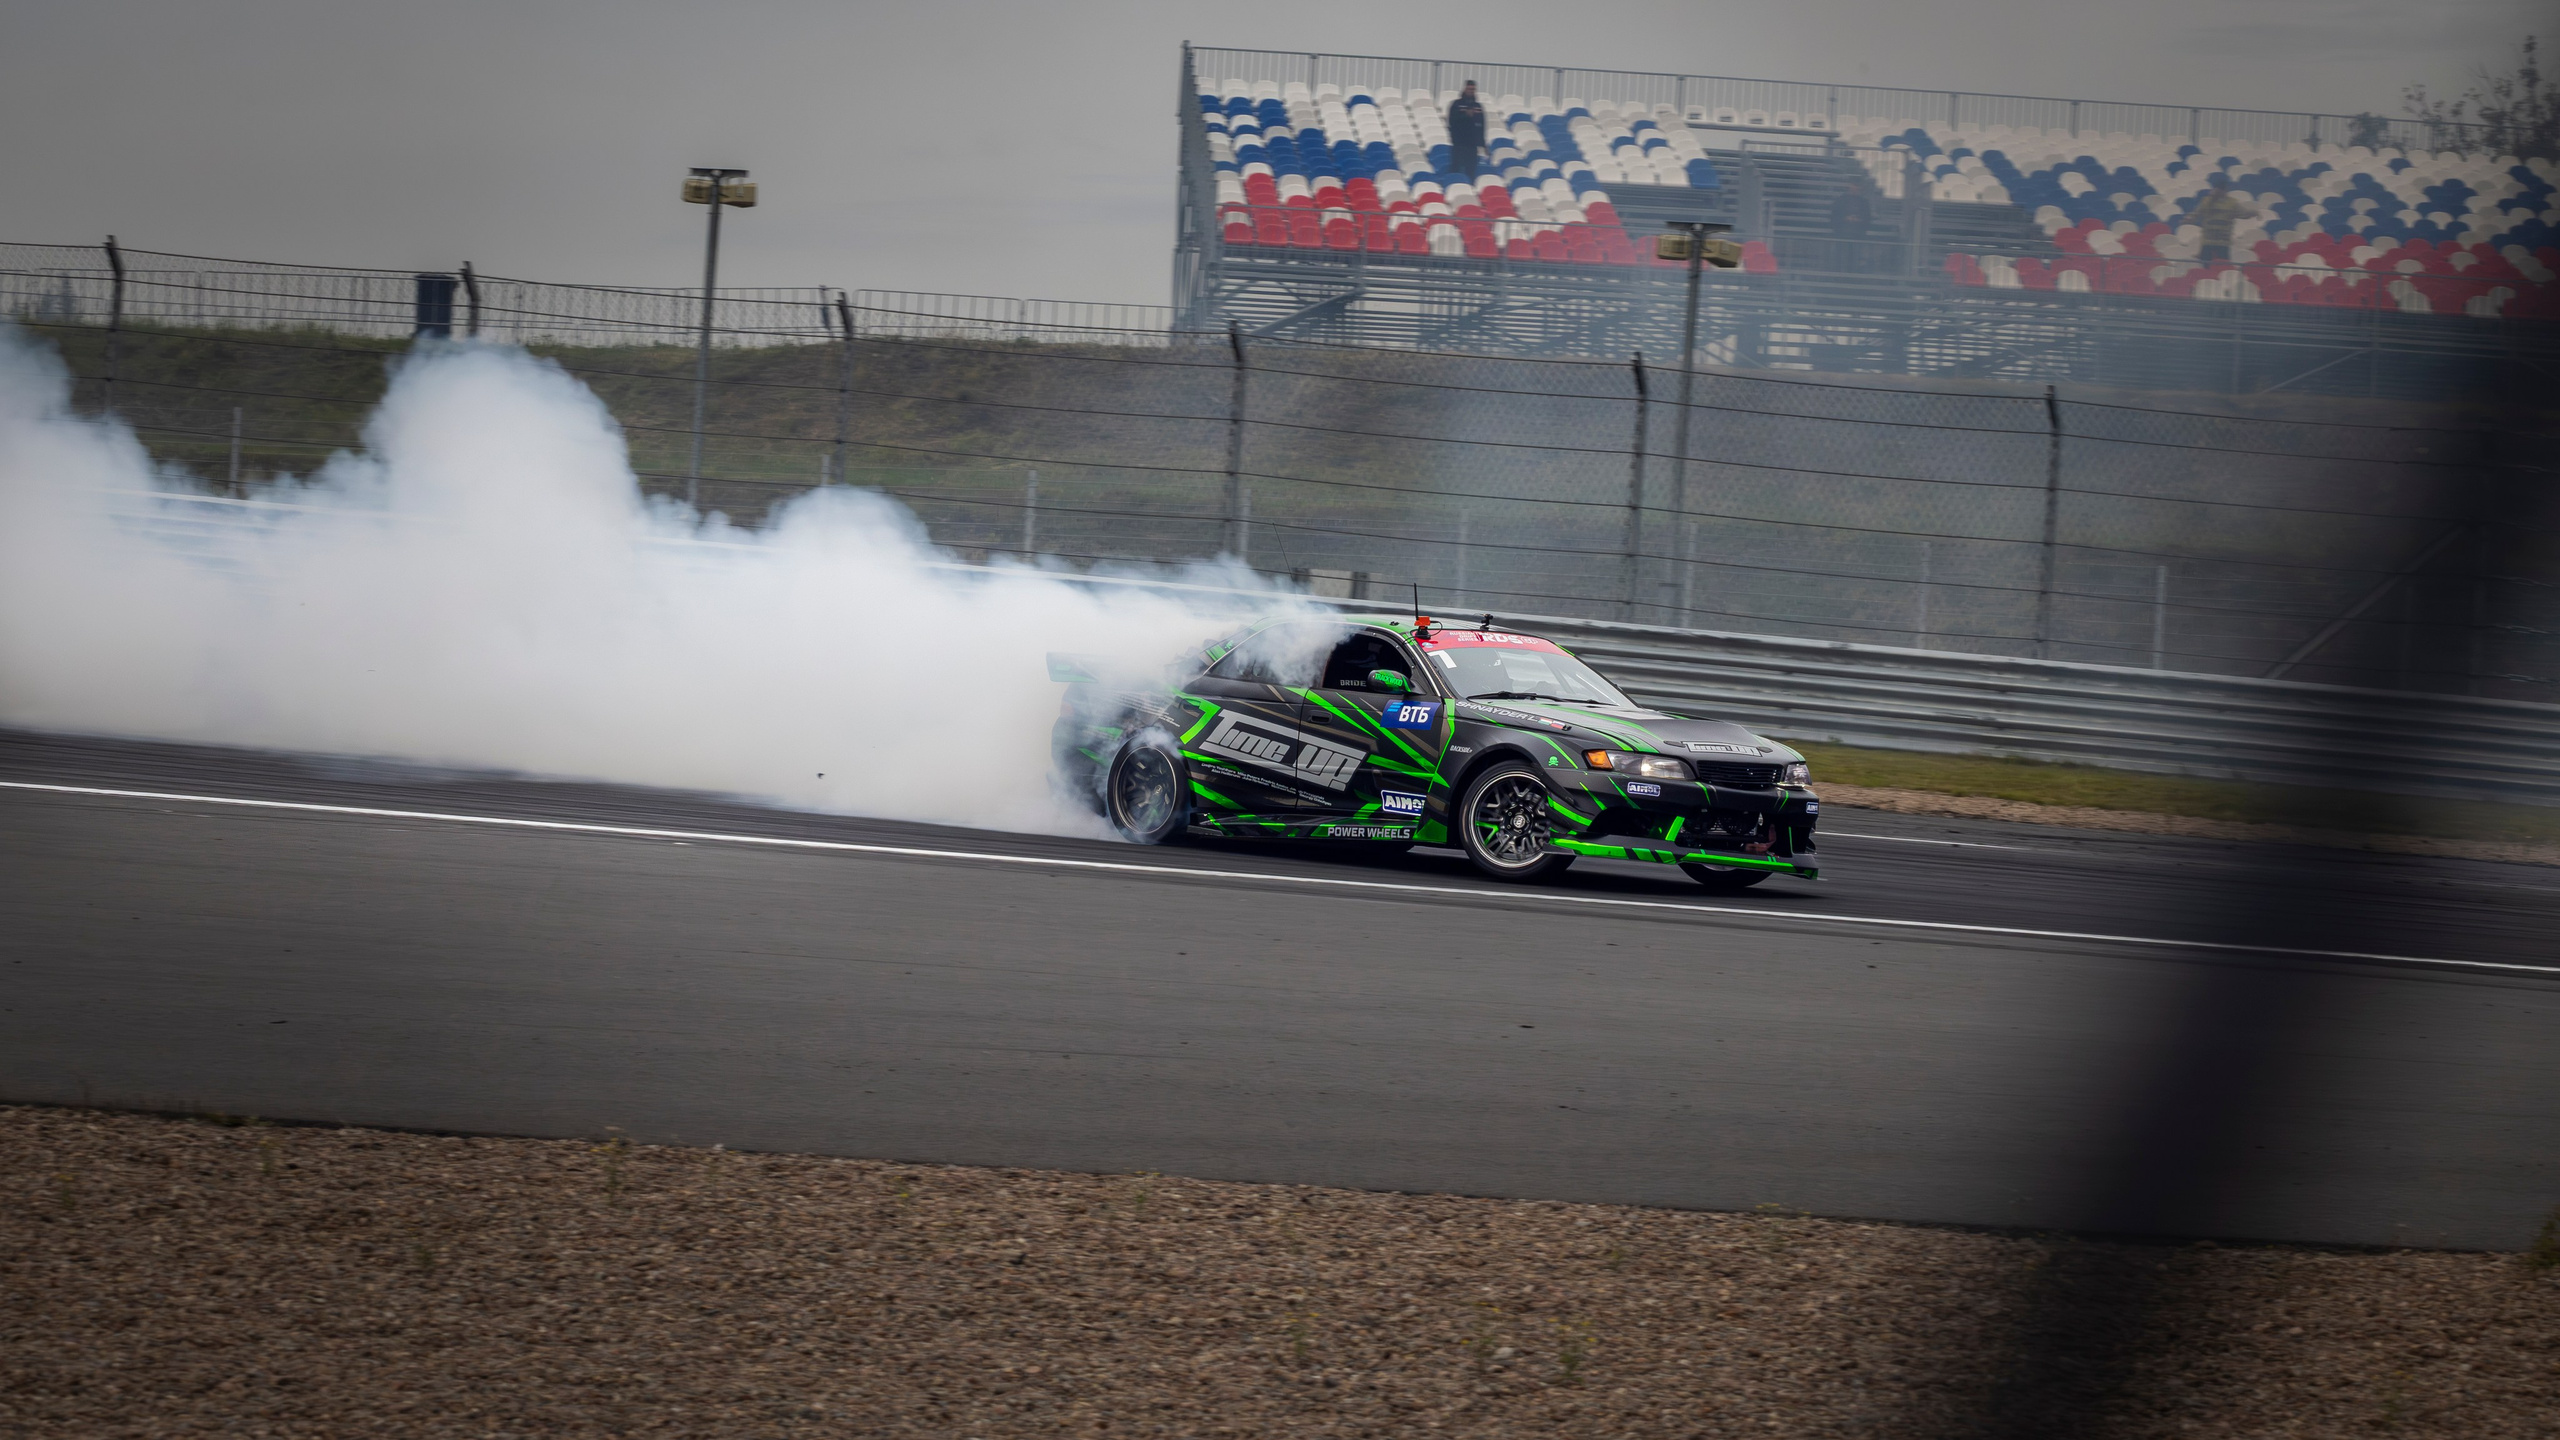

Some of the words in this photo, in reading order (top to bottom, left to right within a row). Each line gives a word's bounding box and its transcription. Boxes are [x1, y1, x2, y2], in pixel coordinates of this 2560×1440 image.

[1480, 632, 1523, 644] RDS
[1340, 679, 1366, 687] BRIDE
[1398, 705, 1431, 724] ВТБ
[1455, 701, 1528, 719] SHNAYDER
[1327, 826, 1365, 838] POWER
[1367, 827, 1411, 839] WHEELS
